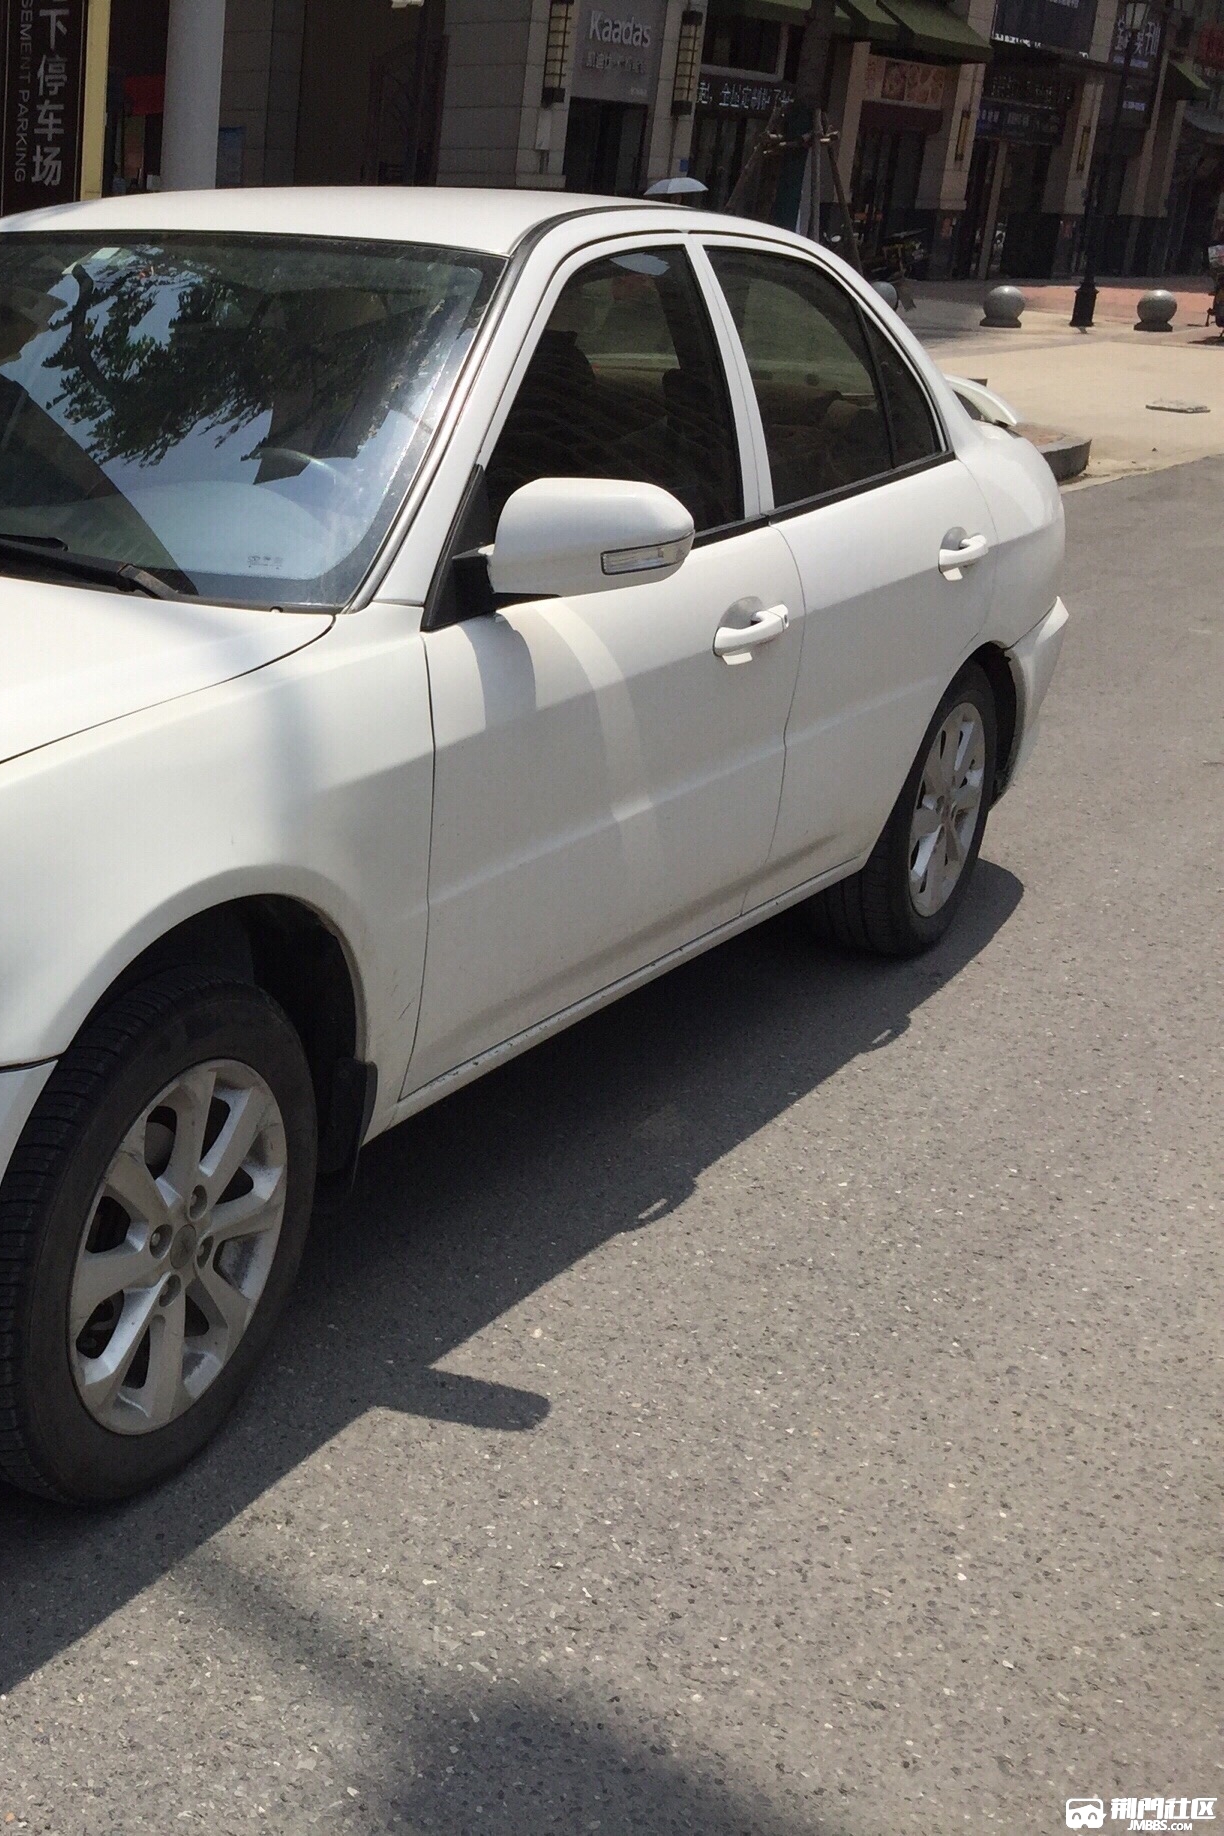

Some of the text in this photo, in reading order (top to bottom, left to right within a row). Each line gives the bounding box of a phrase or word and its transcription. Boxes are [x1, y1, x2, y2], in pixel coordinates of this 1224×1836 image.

[589, 10, 652, 48] Kaadas
[14, 90, 30, 183] PARKING
[31, 0, 70, 187] 下停车场
